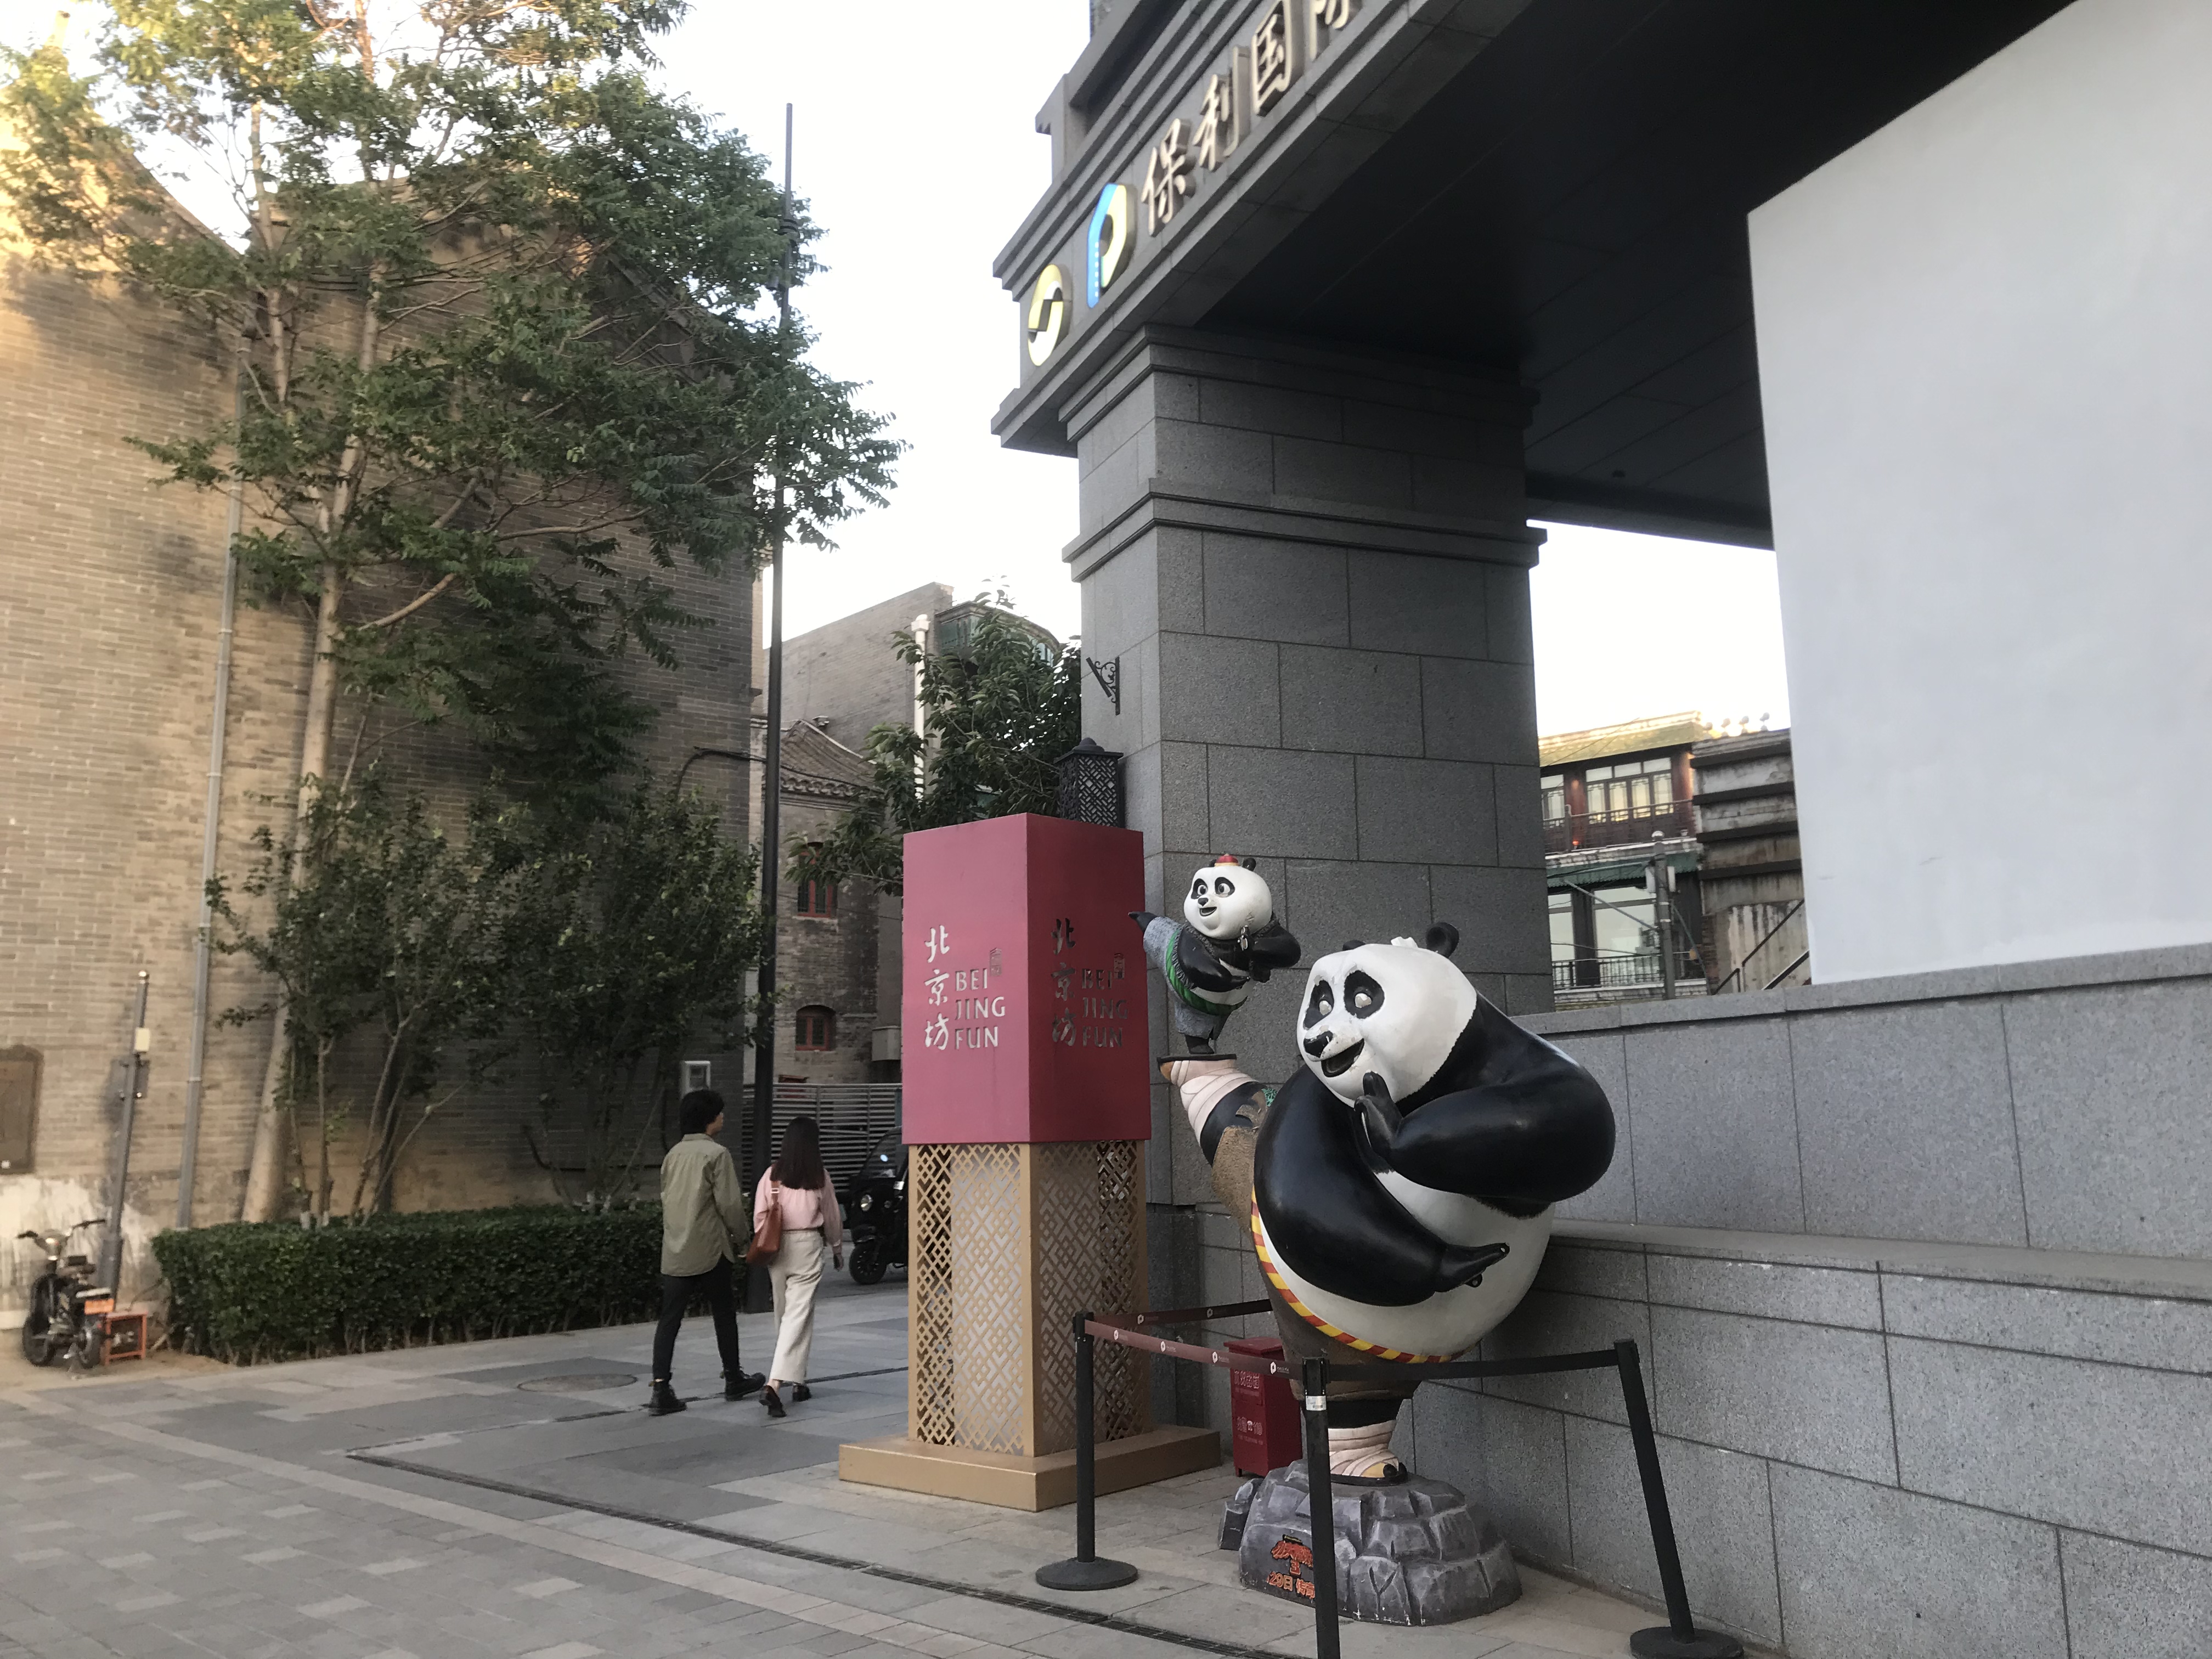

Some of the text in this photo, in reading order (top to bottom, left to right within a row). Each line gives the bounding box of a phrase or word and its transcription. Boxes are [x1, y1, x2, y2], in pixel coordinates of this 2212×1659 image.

[924, 924, 950, 1051] 北京坊
[955, 968, 988, 992] BEI
[1051, 917, 1076, 1047] 北京坊
[1081, 968, 1113, 990] BEI
[955, 996, 1006, 1020] JING
[1082, 997, 1129, 1020] JING
[955, 1026, 999, 1049] FUN
[1082, 1025, 1123, 1048] FUN
